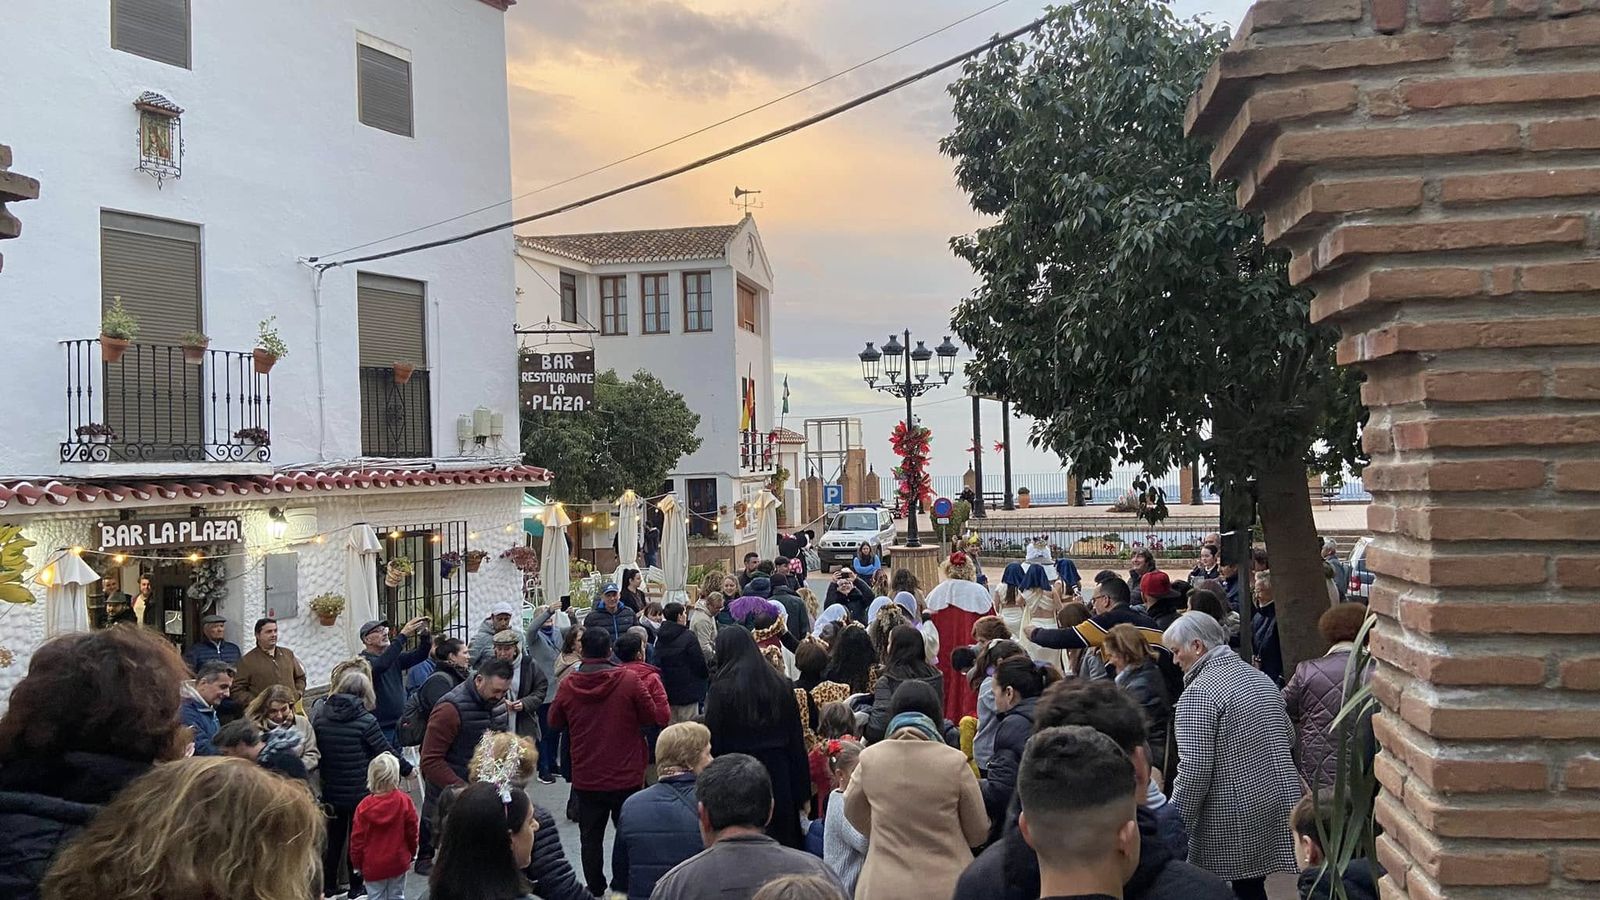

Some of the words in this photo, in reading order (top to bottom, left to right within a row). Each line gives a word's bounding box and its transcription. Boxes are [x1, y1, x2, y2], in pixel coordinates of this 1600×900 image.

[542, 355, 574, 370] BAR
[521, 371, 594, 384] RESTAURANTE
[550, 384, 565, 395] LA
[532, 395, 584, 411] PLAZA
[826, 487, 839, 503] P
[101, 524, 143, 548] BAR
[149, 521, 175, 545] LA
[179, 519, 238, 543] PLAZA
